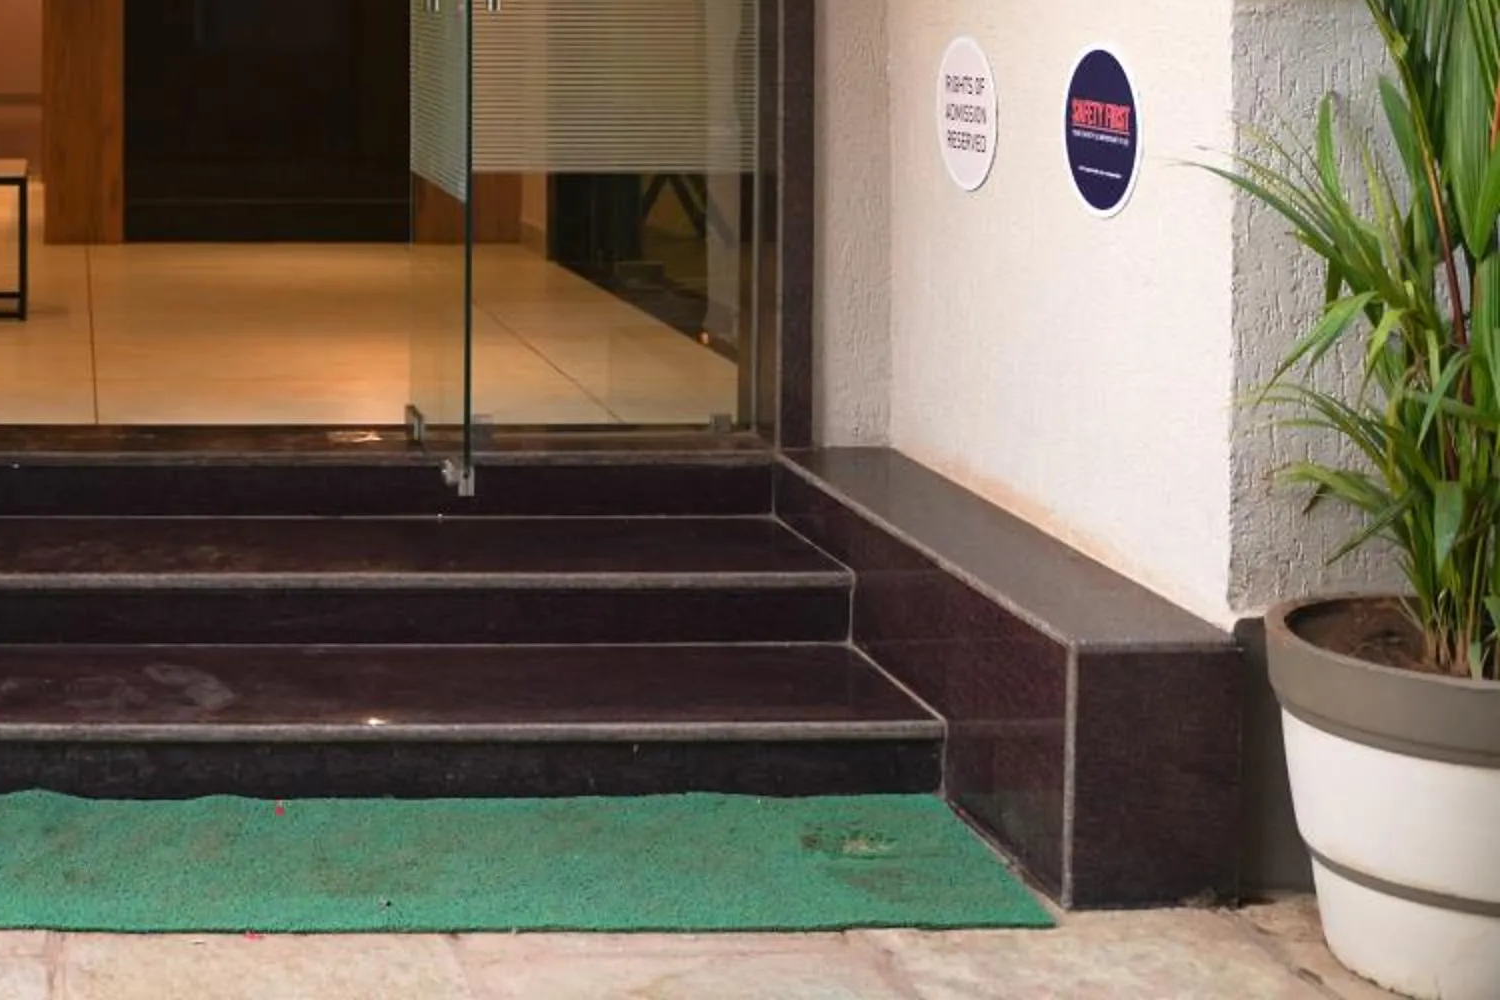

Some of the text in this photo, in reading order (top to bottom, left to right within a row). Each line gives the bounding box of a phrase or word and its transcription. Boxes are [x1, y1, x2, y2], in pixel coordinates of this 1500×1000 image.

[945, 74, 985, 95] RIGHTS OF
[945, 103, 987, 124] ADMISSION
[1072, 98, 1131, 132] SAFETY FIRST
[947, 130, 987, 153] RESERVED
